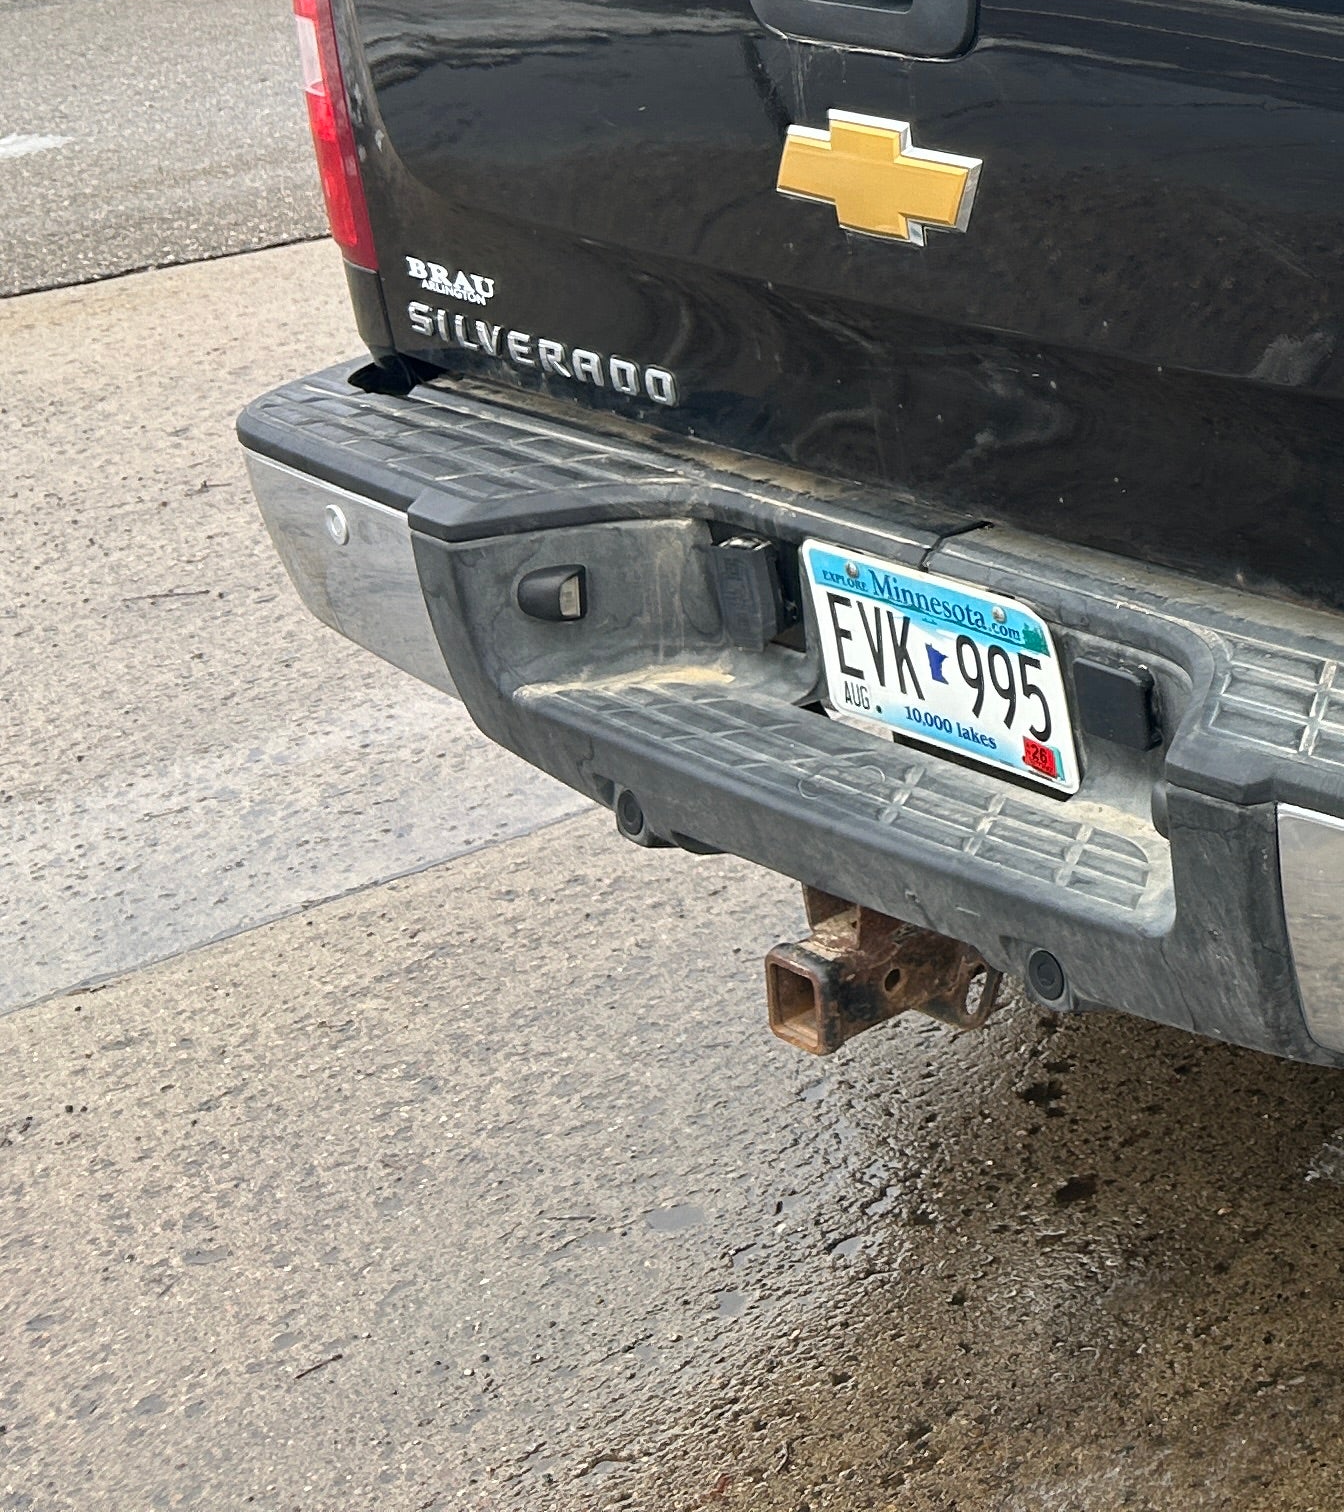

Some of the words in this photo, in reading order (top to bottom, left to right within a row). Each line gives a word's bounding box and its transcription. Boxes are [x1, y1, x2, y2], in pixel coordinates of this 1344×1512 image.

[405, 255, 495, 299] BRAU
[407, 300, 680, 407] SILVERADO
[822, 569, 867, 592] EXPLORE
[826, 591, 925, 702] EVK
[955, 634, 1052, 742] 995
[844, 680, 871, 710] AUG
[956, 721, 998, 750] lakes
